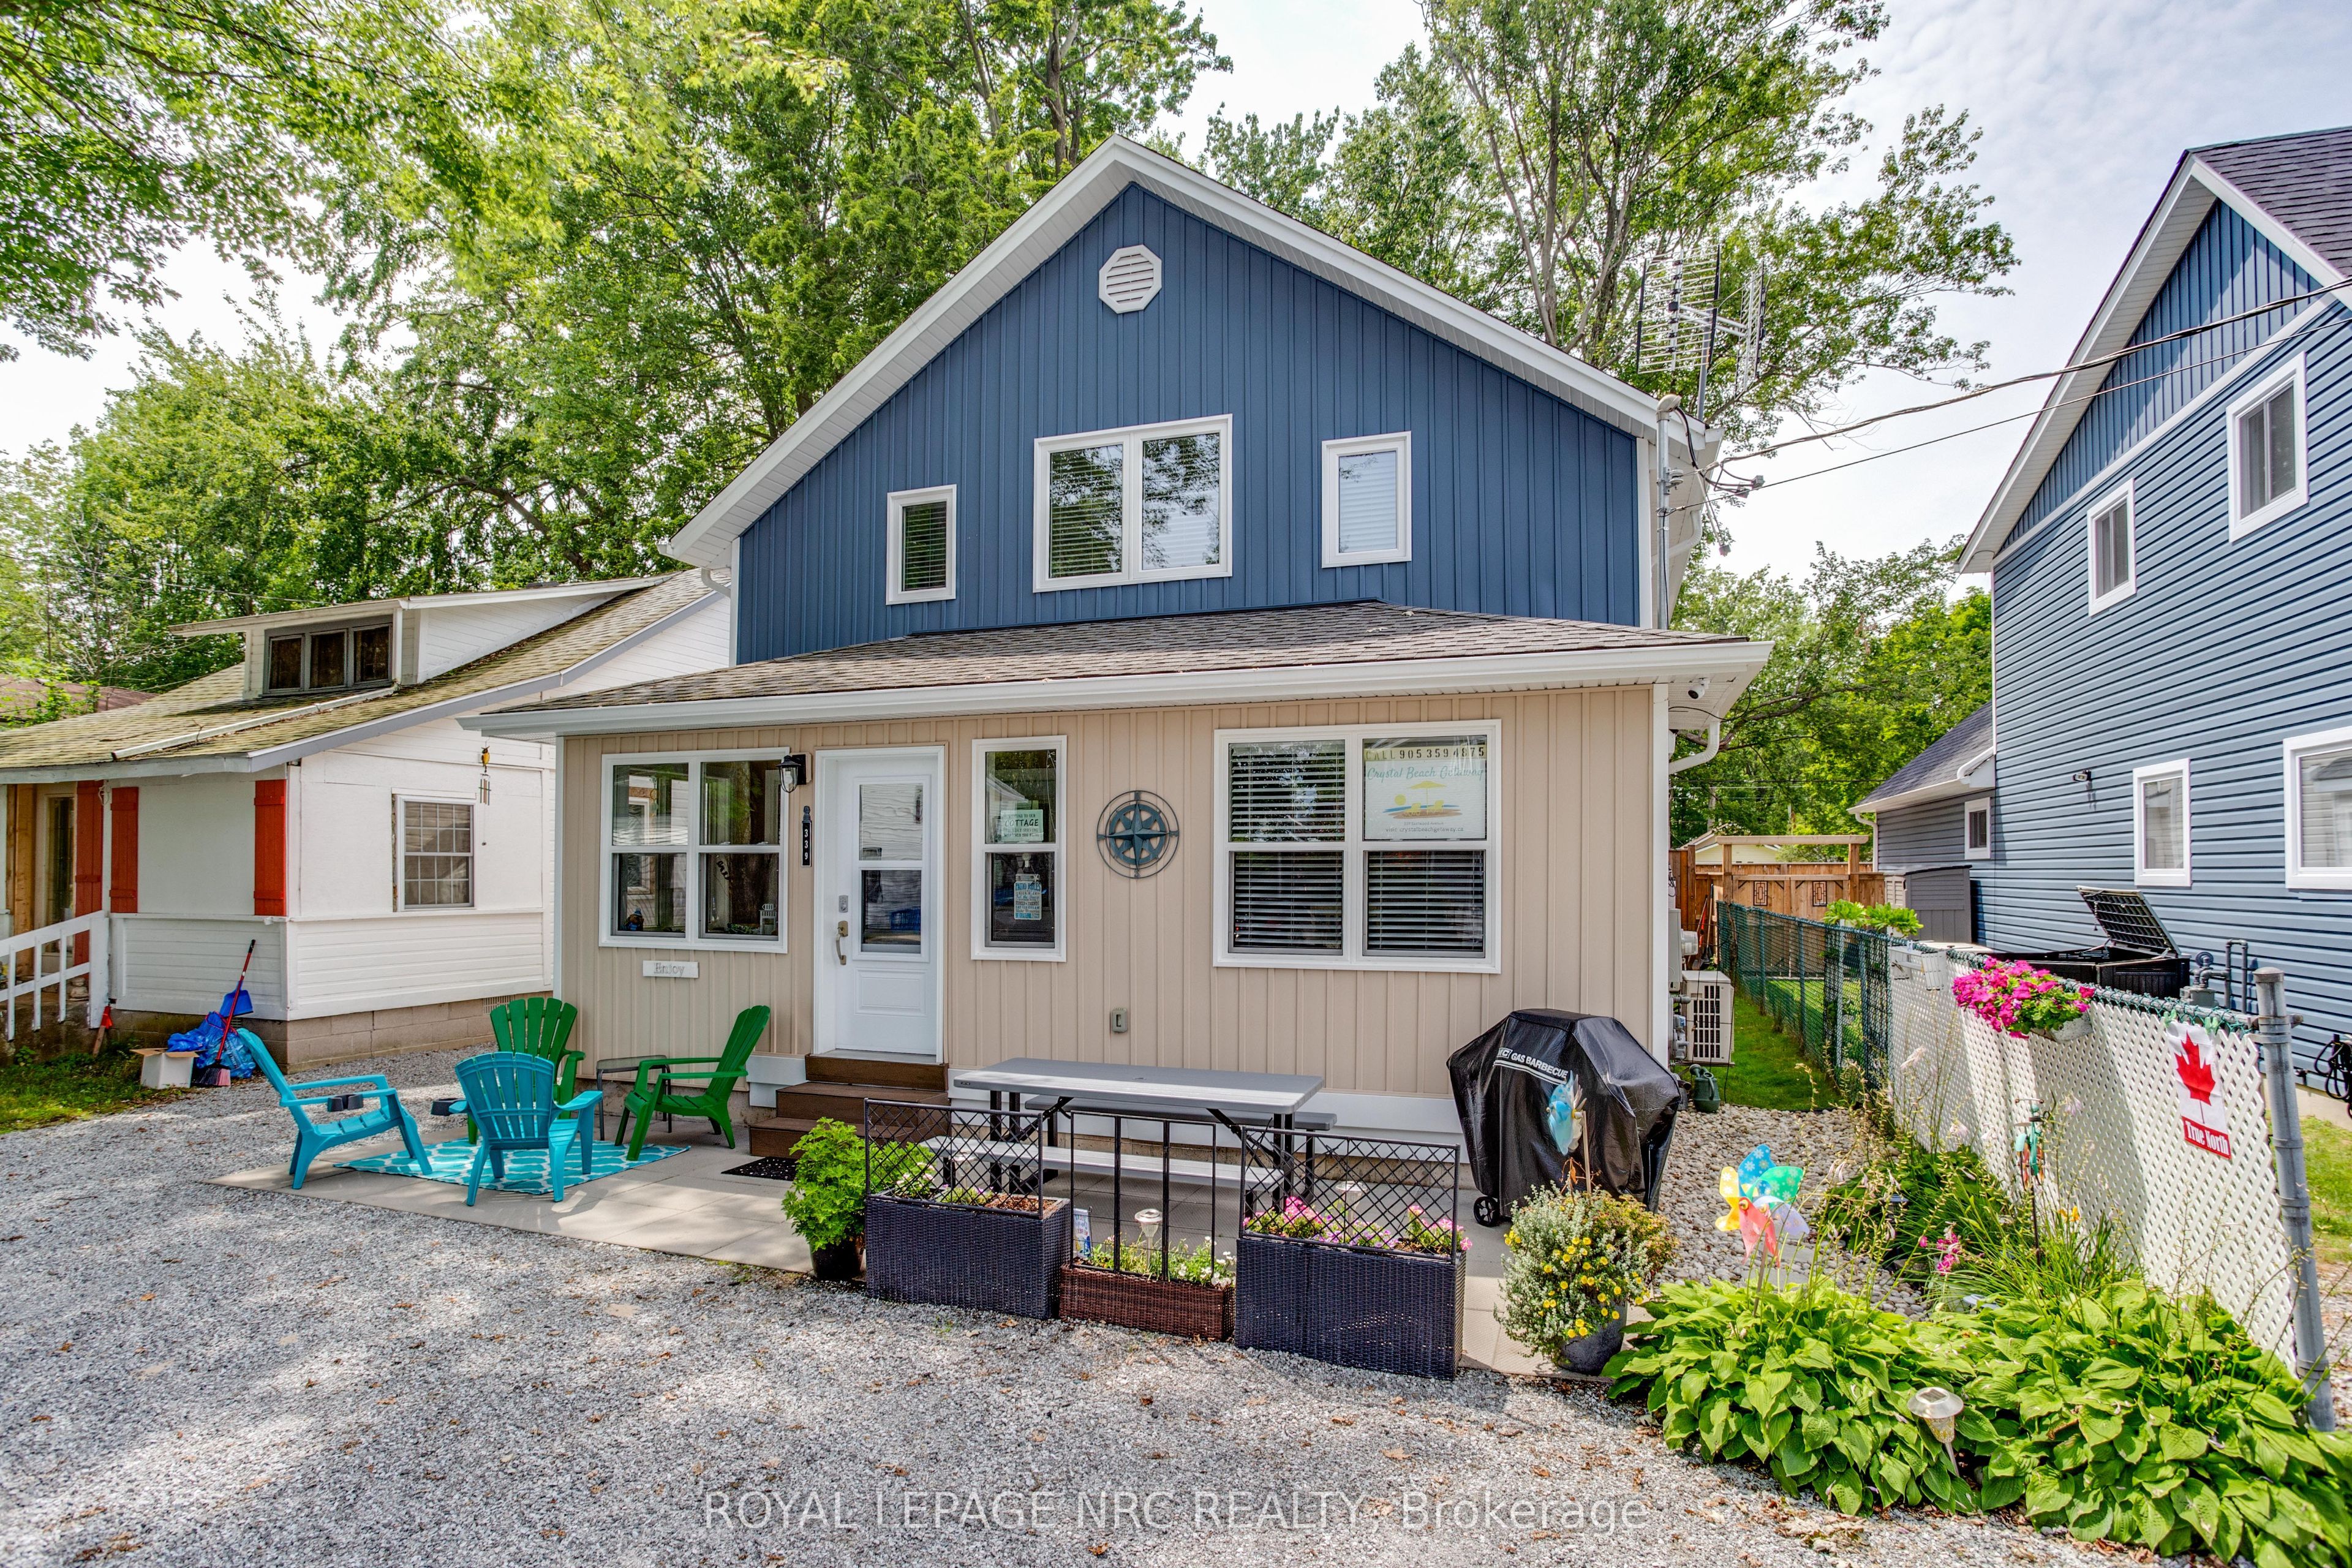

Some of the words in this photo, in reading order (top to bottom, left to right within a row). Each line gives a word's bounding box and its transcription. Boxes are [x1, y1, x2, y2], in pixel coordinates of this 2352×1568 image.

[1366, 750, 1395, 760] CALL
[1400, 748, 1422, 759] 905
[1427, 748, 1449, 758] 359
[1453, 747, 1484, 758] 4875
[1367, 767, 1403, 783] Crystal
[1406, 766, 1436, 780] Beach
[1440, 766, 1483, 781] Getaway
[654, 962, 685, 978] Enjoy
[1511, 1053, 1526, 1063] GAS
[1526, 1056, 1569, 1078] BARBECUE
[2185, 1120, 2205, 1145] True
[2205, 1129, 2230, 1156] North
